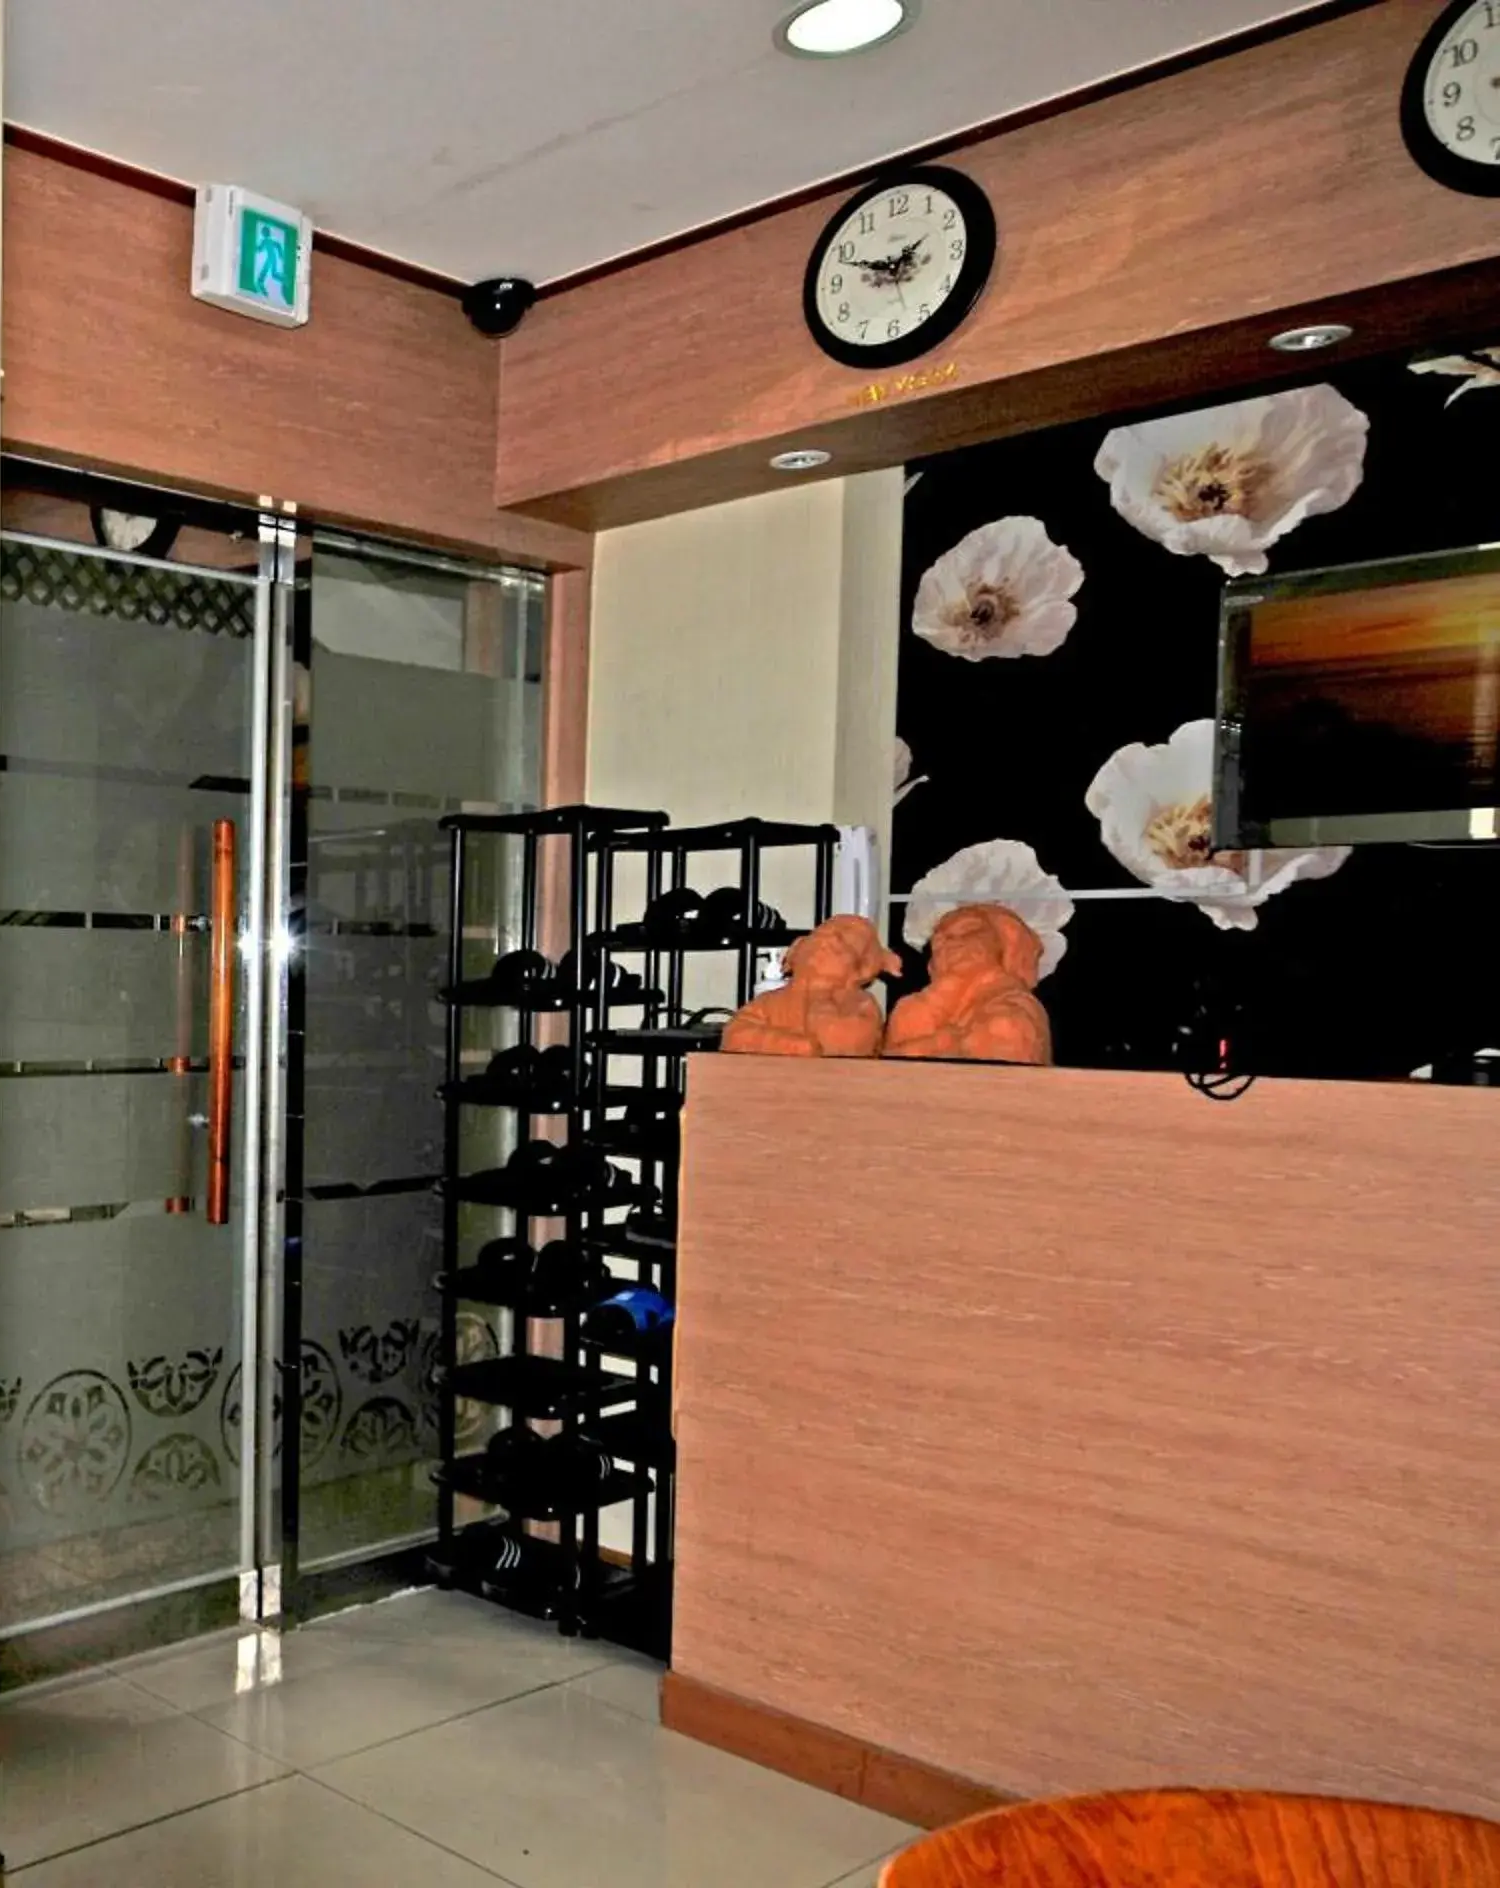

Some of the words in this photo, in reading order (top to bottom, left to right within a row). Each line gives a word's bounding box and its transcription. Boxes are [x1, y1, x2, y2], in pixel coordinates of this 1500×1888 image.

[1451, 39, 1478, 68] 10
[1443, 81, 1461, 107] 9
[1456, 115, 1475, 142] 8
[889, 194, 909, 218] 12
[925, 195, 934, 214] 1
[860, 211, 875, 235] 11
[942, 209, 956, 231] 2
[838, 241, 855, 264] 10
[950, 240, 963, 260] 3
[831, 274, 843, 294] 9
[838, 302, 850, 323] 8
[918, 303, 931, 322] 5
[858, 319, 870, 339] 7
[887, 319, 901, 338] 6
